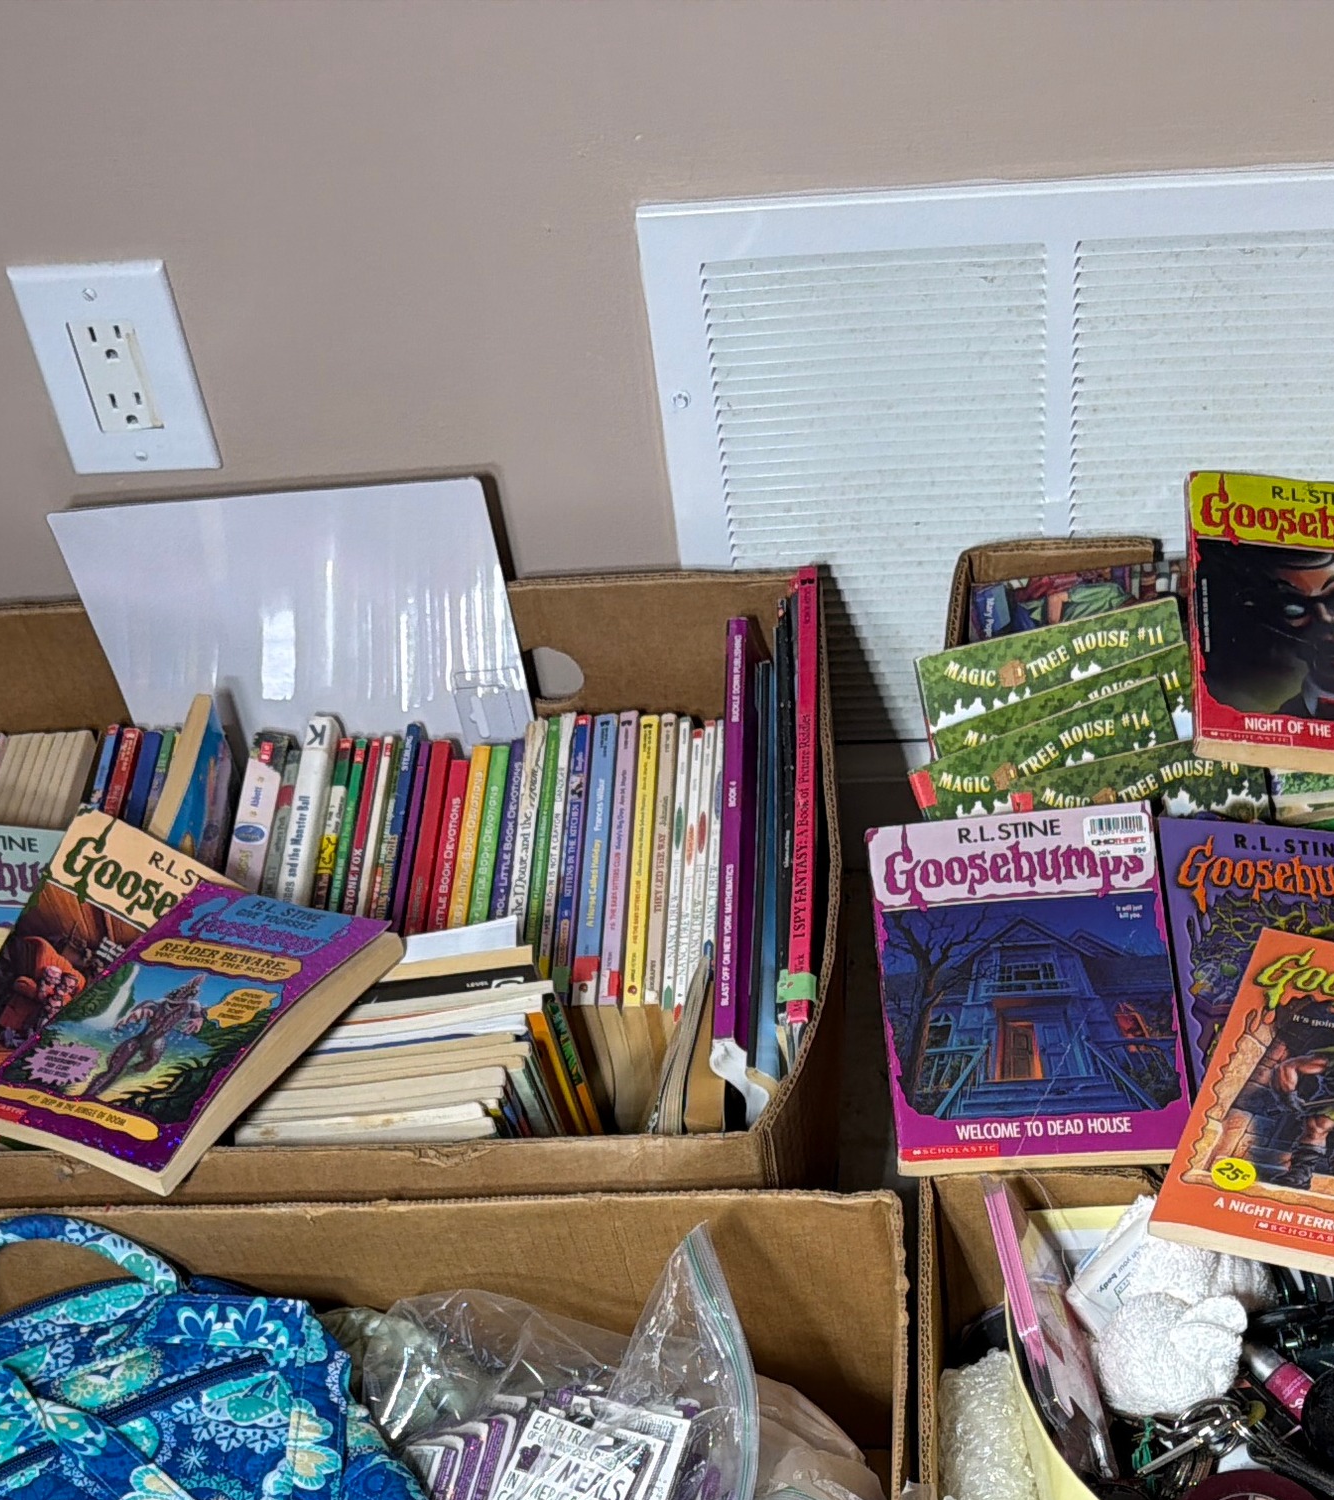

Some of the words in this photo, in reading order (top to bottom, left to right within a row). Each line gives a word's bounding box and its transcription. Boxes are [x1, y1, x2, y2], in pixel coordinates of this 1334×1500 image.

[732, 634, 743, 673] PUBLISHING
[944, 660, 996, 688] MAGIC
[1026, 644, 1070, 679] TREE
[1073, 630, 1130, 656] HOUSE
[1137, 625, 1163, 646] #11
[731, 697, 741, 723] BUCKLE
[307, 724, 326, 746] K
[1244, 717, 1284, 733] NIGHT
[1287, 720, 1305, 735] OF
[1307, 721, 1332, 737] THE
[938, 770, 991, 793] MAGIC
[1018, 742, 1060, 777] TREE
[1060, 720, 1116, 748] HOUSE
[1121, 711, 1151, 730] #14
[297, 795, 310, 811] Ball
[507, 762, 522, 818] DEVOTIONS
[728, 787, 738, 808] BOOK
[291, 812, 307, 845] Monster
[443, 797, 461, 859] DEVOTIONS
[483, 785, 498, 843] DEVOTIONS
[504, 821, 514, 850] BOOK
[1000, 819, 1061, 841] STINE
[350, 848, 363, 871] FOX
[479, 846, 489, 874] BOOK
[499, 853, 510, 887] LITTLE
[794, 838, 809, 902] FANTASY:
[440, 861, 452, 893] BOOK
[724, 864, 736, 914] MATHEMATICS
[344, 873, 359, 913] STONE
[475, 876, 485, 910] LITTLE
[794, 906, 807, 932] SPY
[159, 941, 220, 960] READER
[955, 1121, 1021, 1141] WELCOME
[1024, 1120, 1043, 1137] TO
[1047, 1118, 1083, 1136] DEAD
[1087, 1116, 1132, 1134] HOUSE
[1229, 1198, 1276, 1220] NIGHT
[1278, 1208, 1294, 1223] IN
